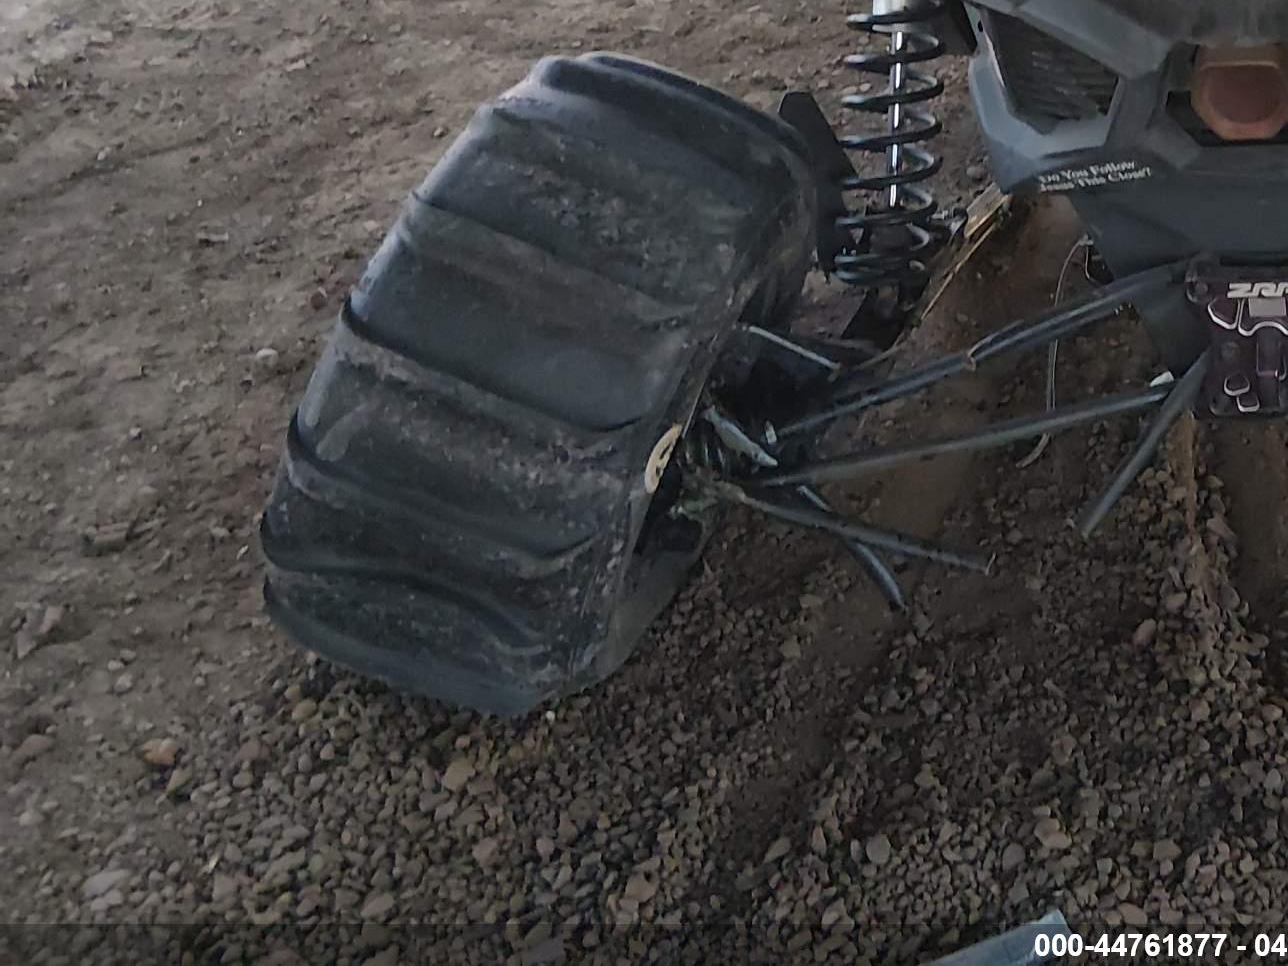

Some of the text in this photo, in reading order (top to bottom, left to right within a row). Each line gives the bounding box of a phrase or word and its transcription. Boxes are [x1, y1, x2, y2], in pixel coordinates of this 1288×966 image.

[1060, 169, 1088, 180] You
[1089, 161, 1135, 175] Follow
[1074, 177, 1106, 187] This
